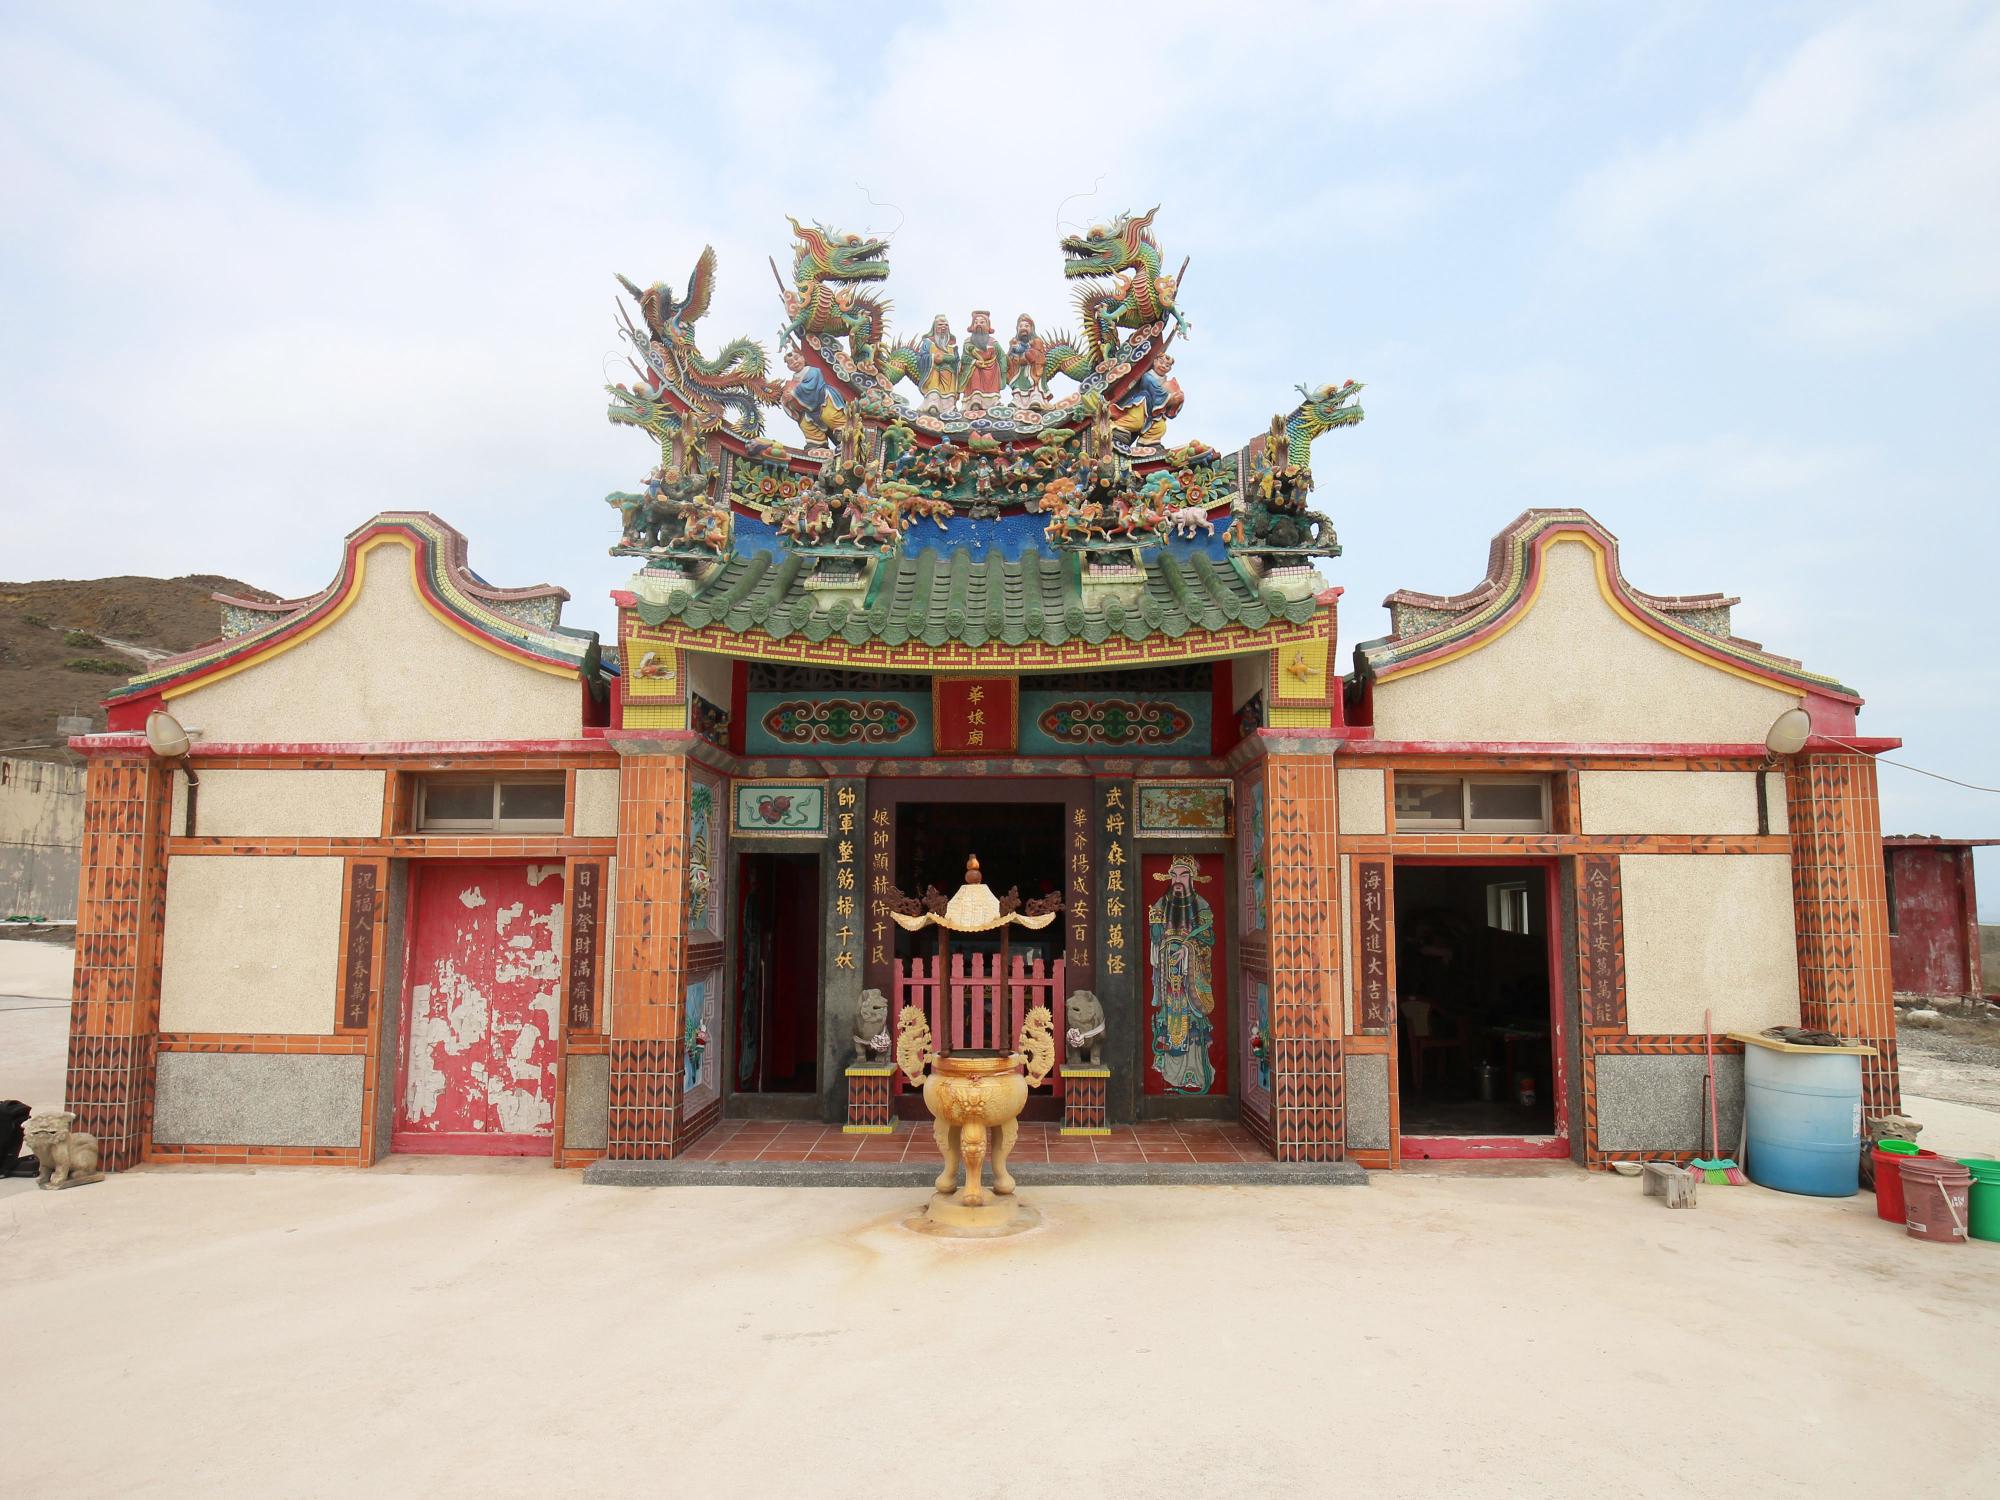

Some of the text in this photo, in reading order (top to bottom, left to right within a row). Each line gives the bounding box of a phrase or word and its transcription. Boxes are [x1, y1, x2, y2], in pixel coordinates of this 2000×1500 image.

[967, 685, 986, 746] 華娘廟
[1105, 786, 1127, 975] 武將森嚴除萬怪
[1364, 870, 1384, 1022] 海利大進大吉成
[1590, 868, 1612, 1022] 合境平安萬萬能
